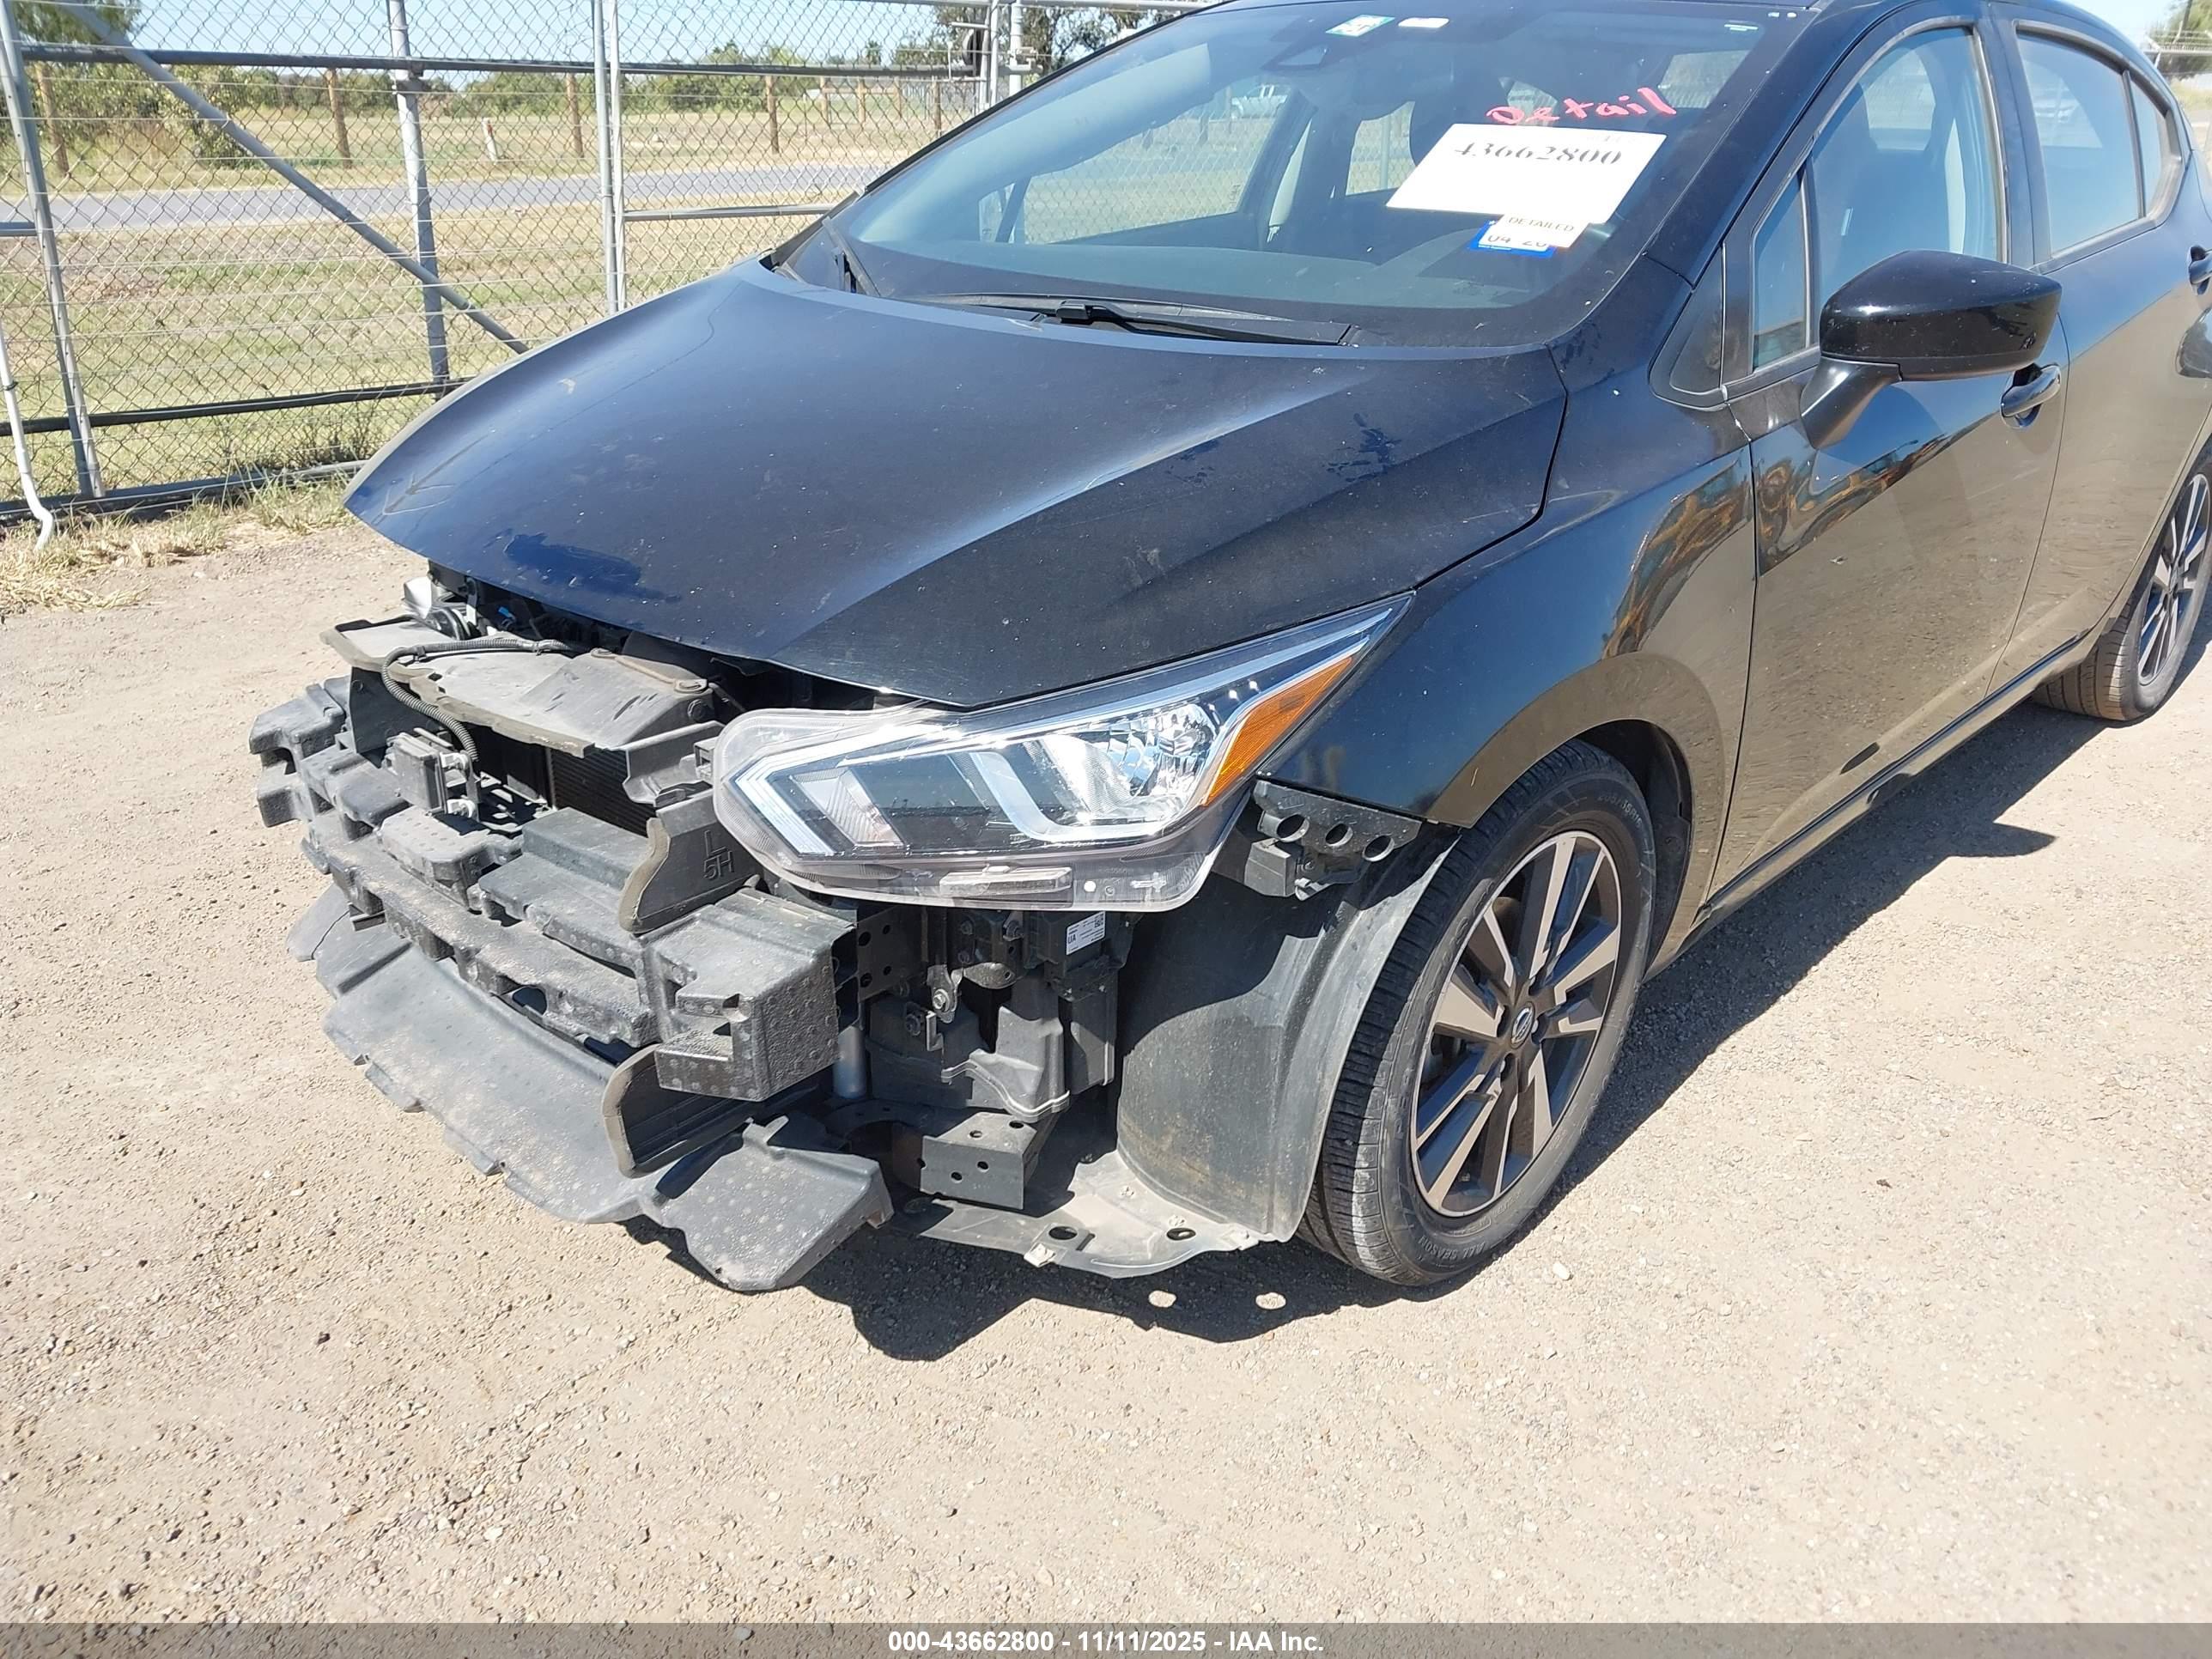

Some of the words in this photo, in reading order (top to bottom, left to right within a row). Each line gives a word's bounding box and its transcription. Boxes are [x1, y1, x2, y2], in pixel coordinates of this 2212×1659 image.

[1486, 88, 1677, 125] Detail
[1455, 142, 1621, 165] 43662800
[1508, 216, 1575, 233] DETAILED
[1417, 1235, 1459, 1261] SEASON
[1462, 1240, 1486, 1260] ALL
